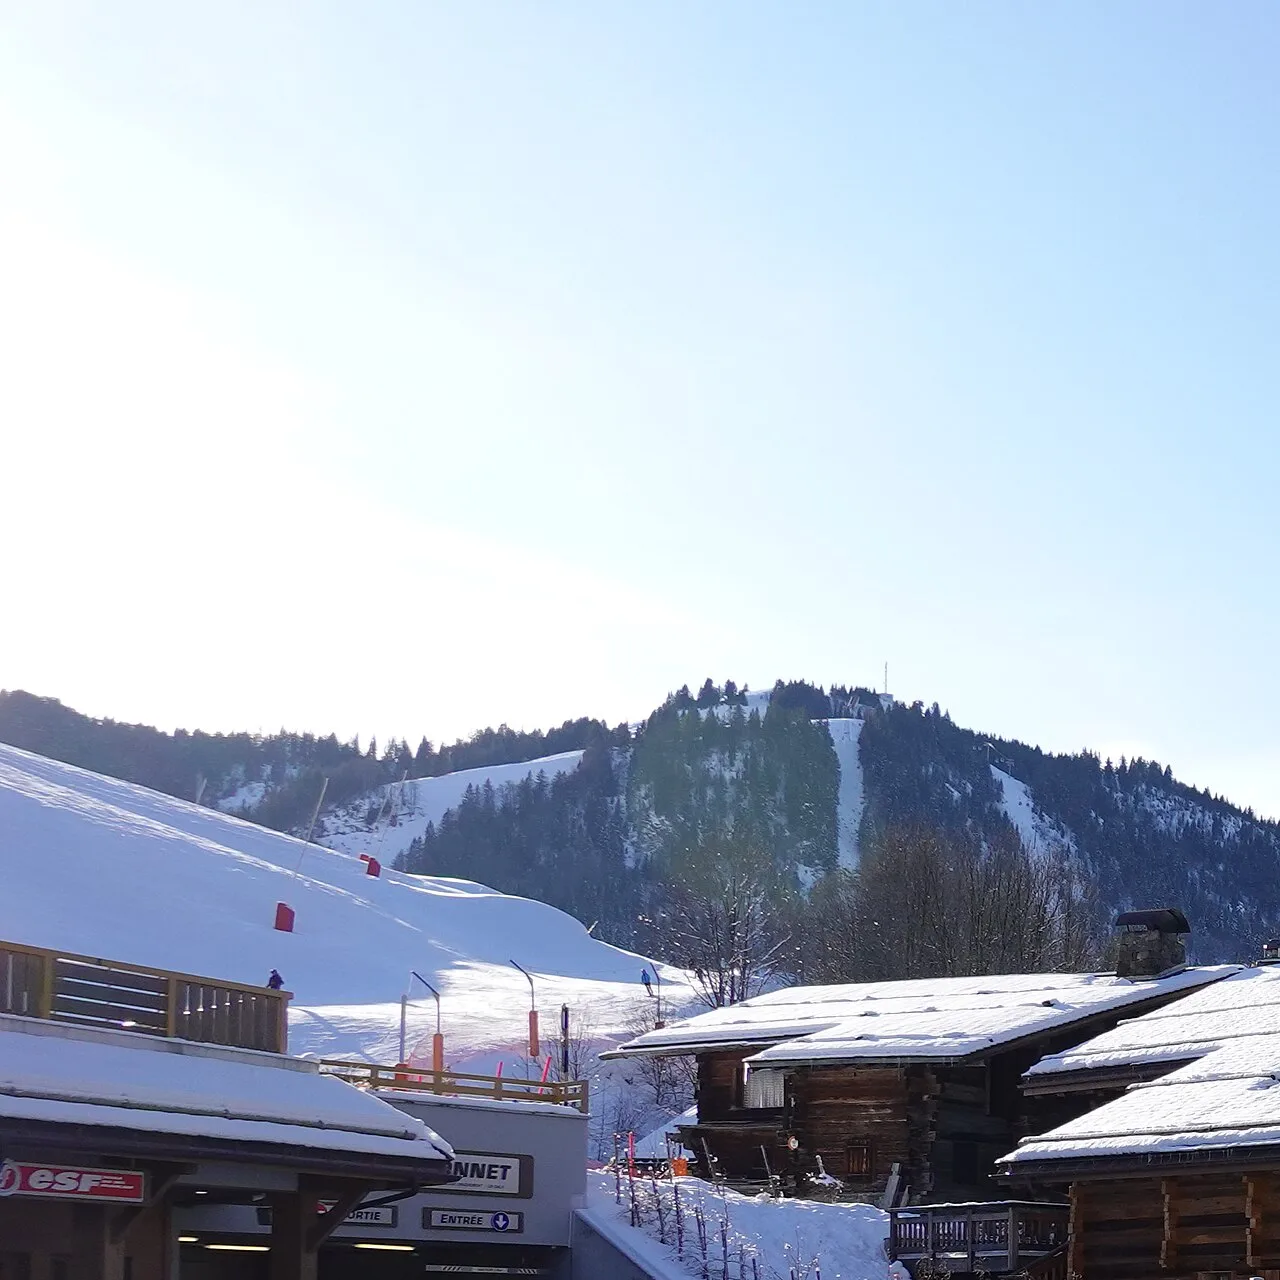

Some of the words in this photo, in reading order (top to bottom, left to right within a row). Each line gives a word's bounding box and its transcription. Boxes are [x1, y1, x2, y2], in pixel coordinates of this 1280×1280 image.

[446, 1161, 512, 1180] NNET
[347, 1210, 381, 1220] ORTIE
[440, 1213, 483, 1225] ENTRÉE
